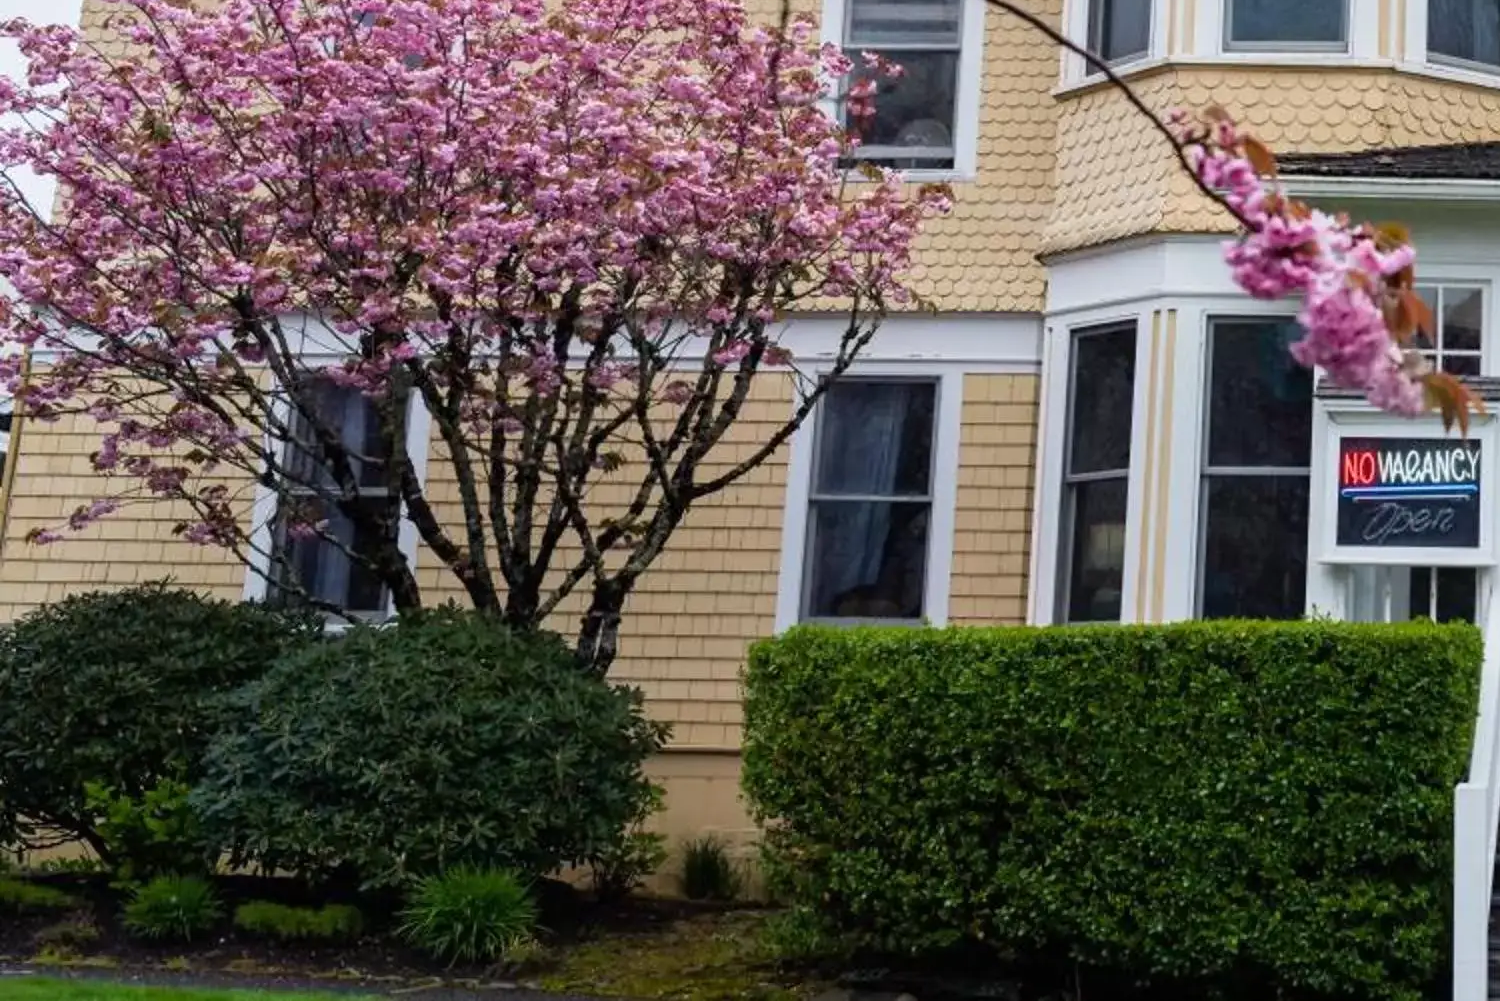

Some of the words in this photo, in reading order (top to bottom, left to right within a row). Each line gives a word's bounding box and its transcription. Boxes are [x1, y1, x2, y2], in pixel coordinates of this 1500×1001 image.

[1344, 452, 1375, 484] NO
[1377, 449, 1481, 483] VACANCY
[1362, 502, 1455, 543] Open
